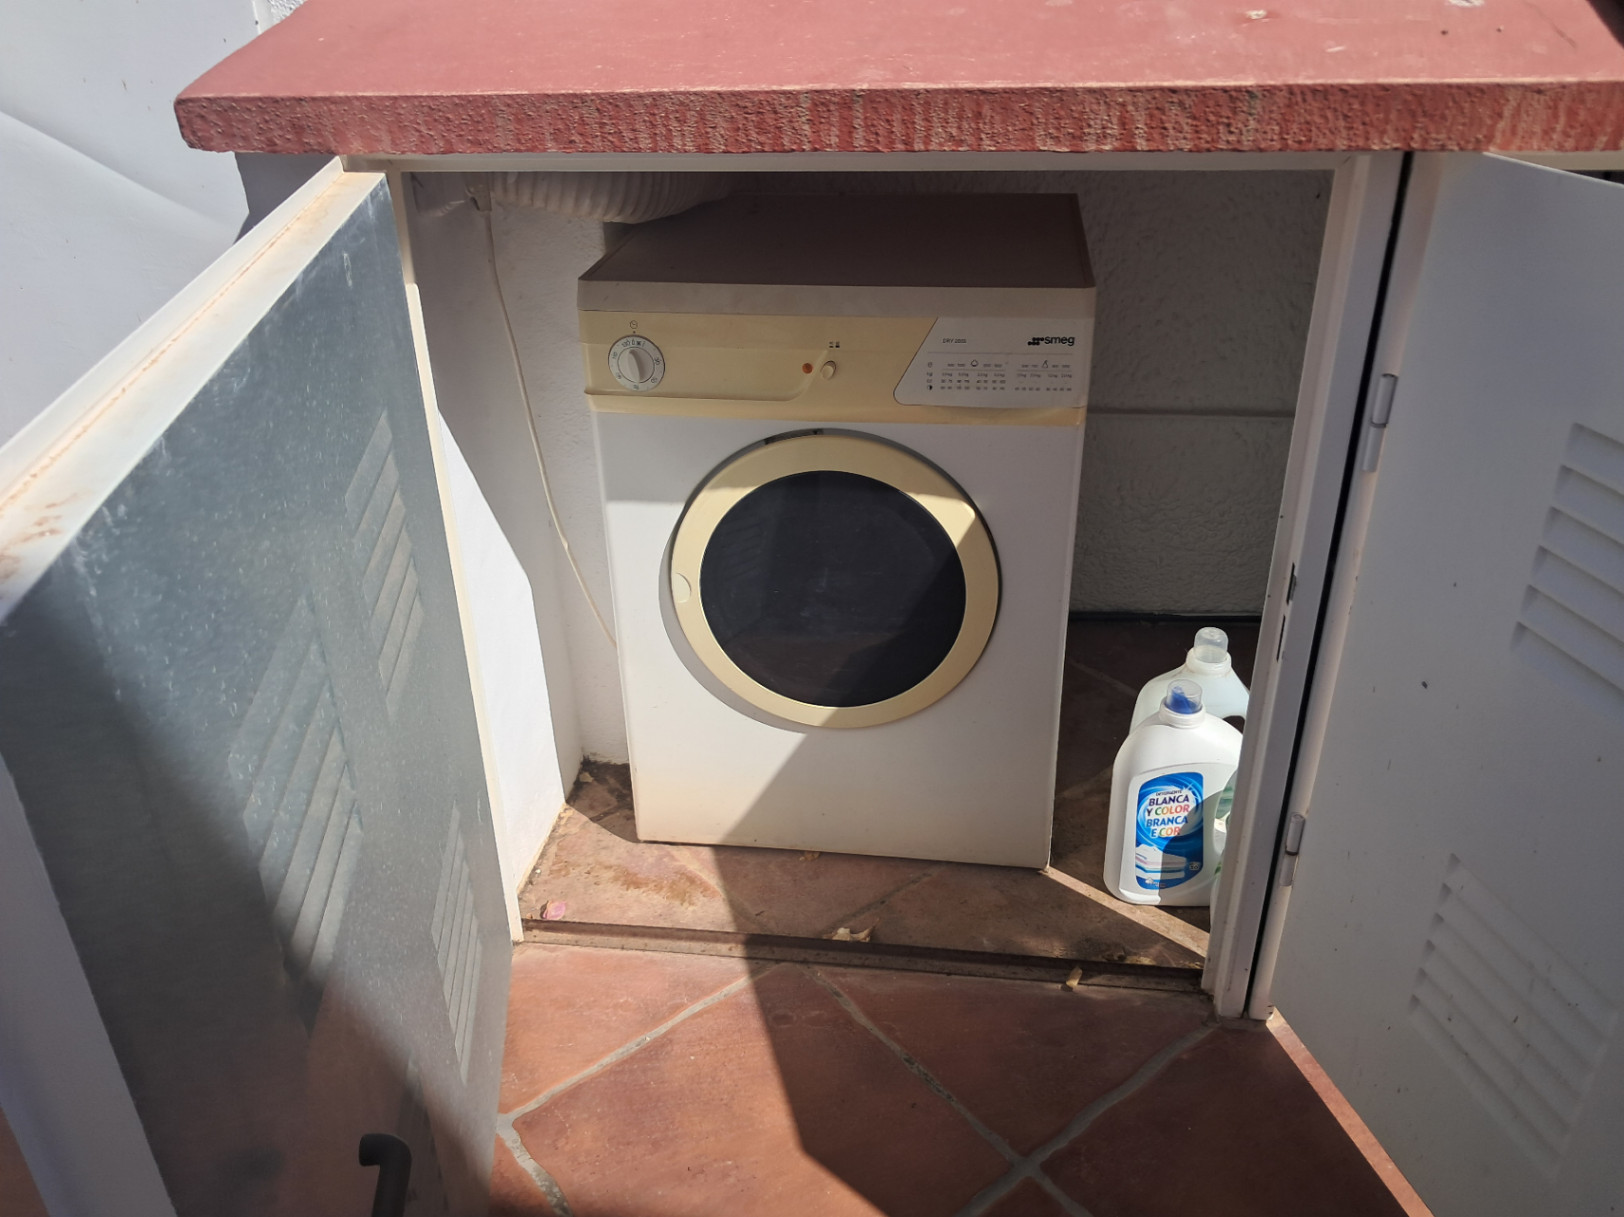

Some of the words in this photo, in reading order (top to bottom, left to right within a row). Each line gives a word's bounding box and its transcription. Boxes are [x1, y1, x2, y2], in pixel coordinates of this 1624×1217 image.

[1044, 336, 1075, 346] smeg
[1149, 794, 1190, 806] BLANCA
[1146, 808, 1153, 816] Y
[1155, 804, 1190, 816] COLOR
[1146, 816, 1188, 827] BRANCA
[1151, 828, 1157, 837] E
[1159, 826, 1181, 837] COR
